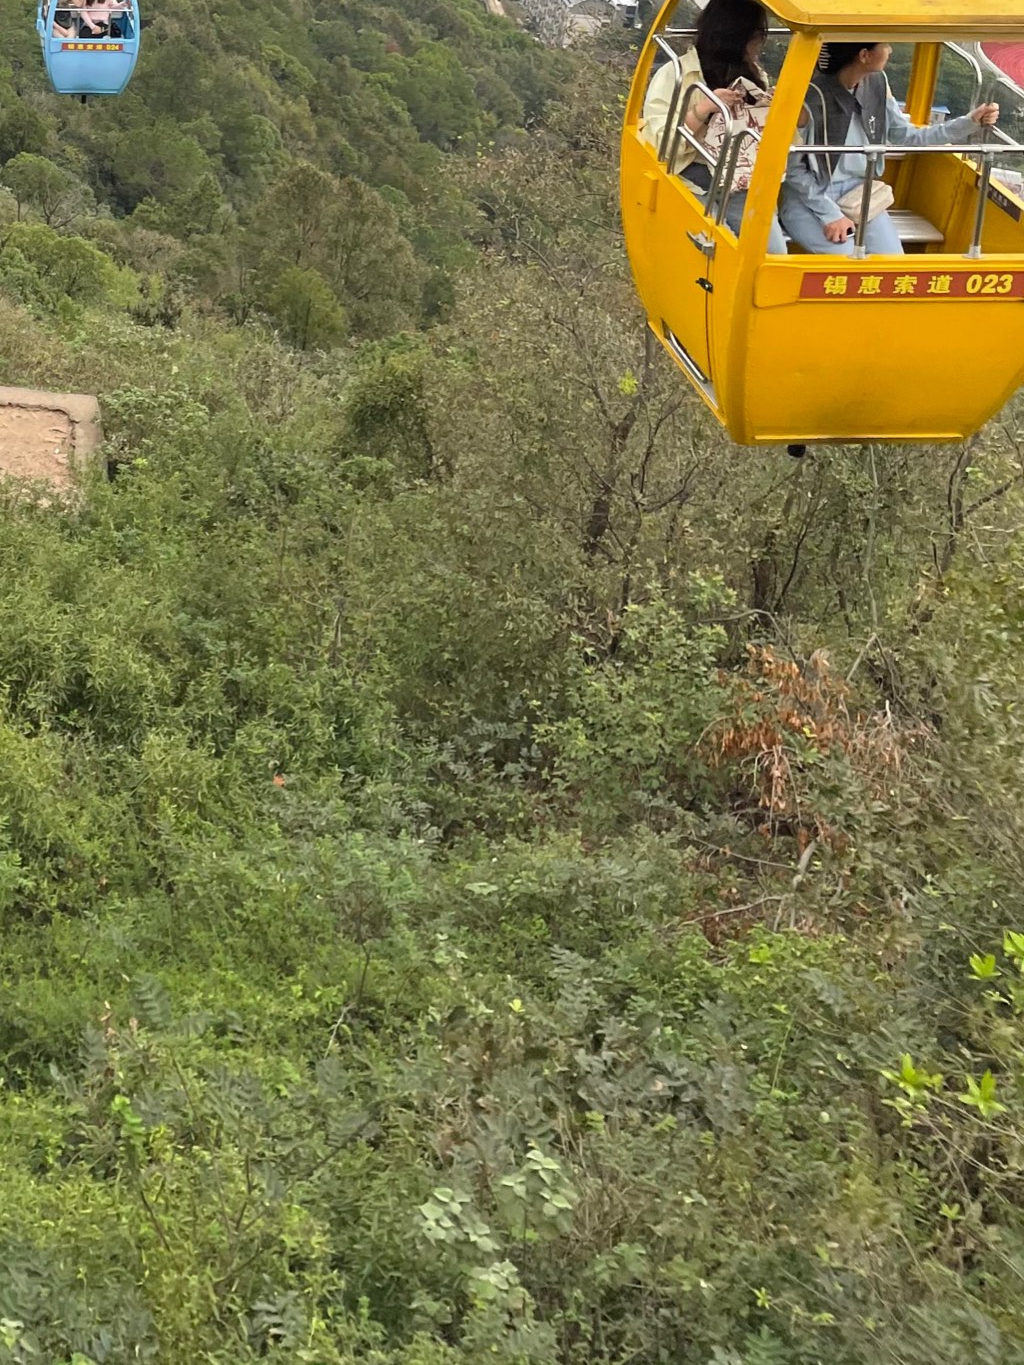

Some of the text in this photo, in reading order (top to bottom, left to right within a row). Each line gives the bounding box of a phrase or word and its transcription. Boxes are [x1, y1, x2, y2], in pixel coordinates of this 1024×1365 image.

[823, 274, 1014, 295] 锡惠索道 023
